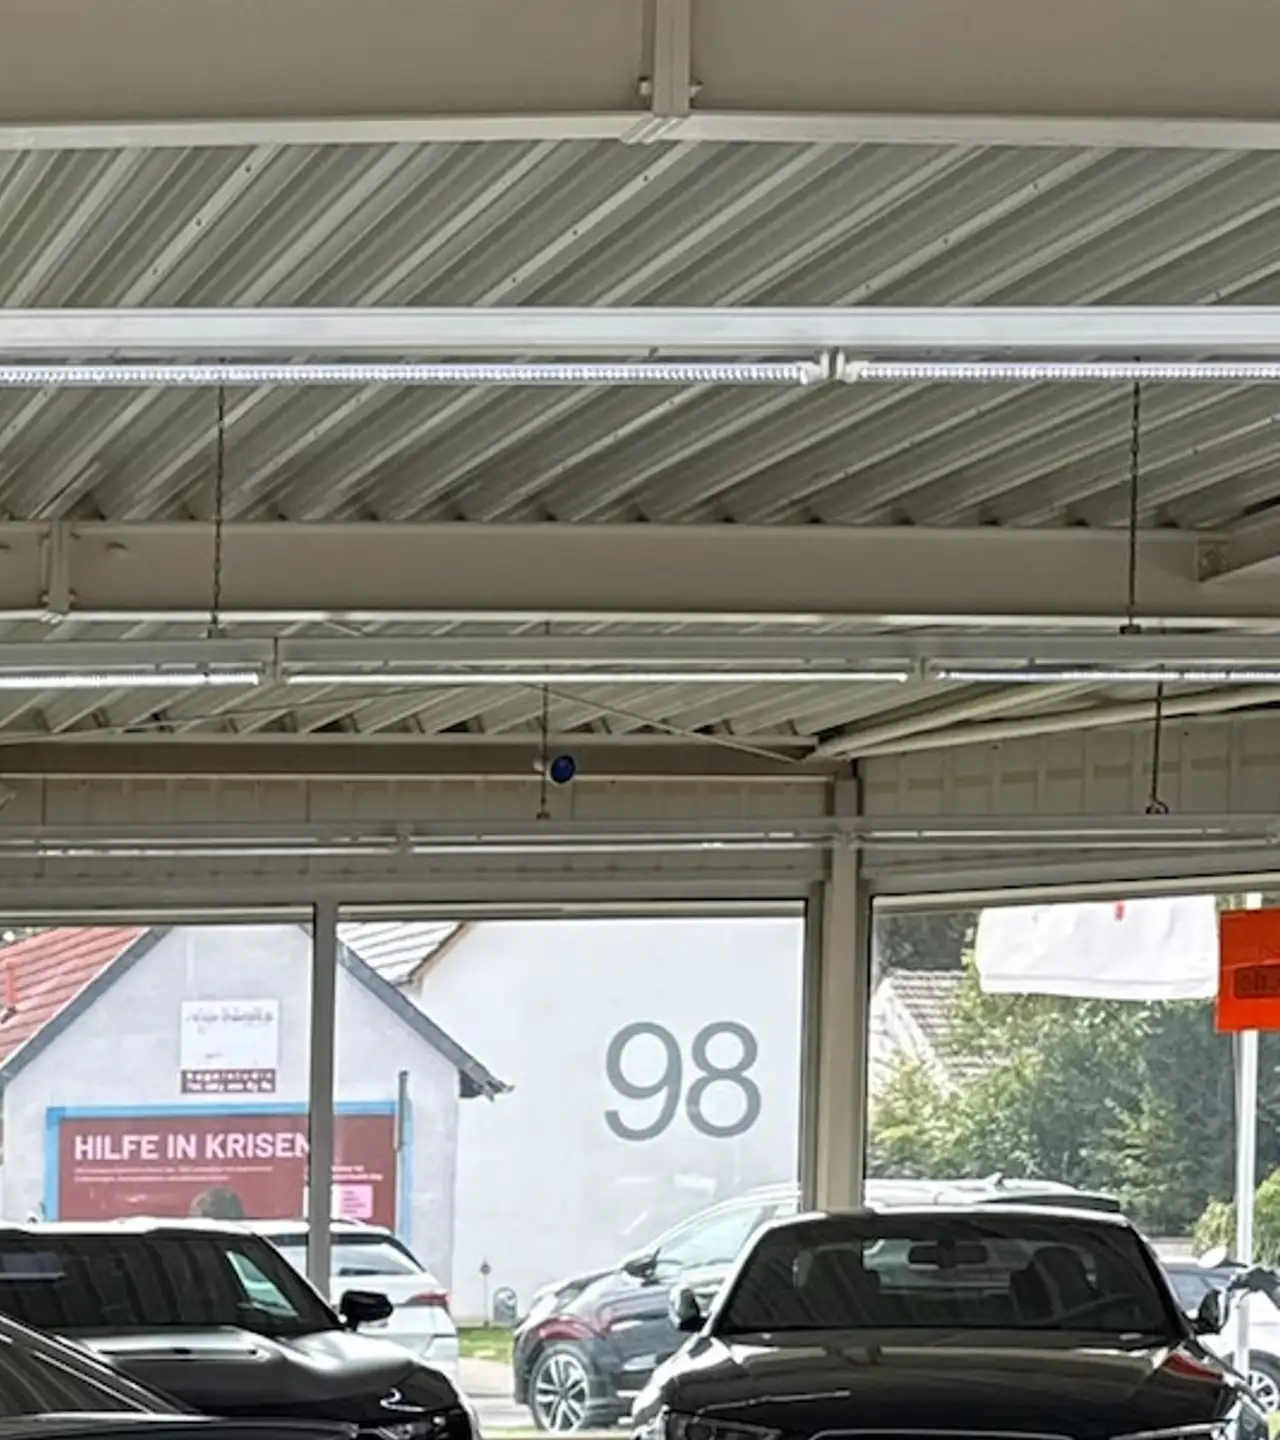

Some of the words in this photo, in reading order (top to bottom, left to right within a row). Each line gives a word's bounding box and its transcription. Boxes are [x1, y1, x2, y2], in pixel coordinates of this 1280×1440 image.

[604, 1021, 762, 1141] 98
[75, 1135, 159, 1161] HILFE
[167, 1135, 197, 1159] IN
